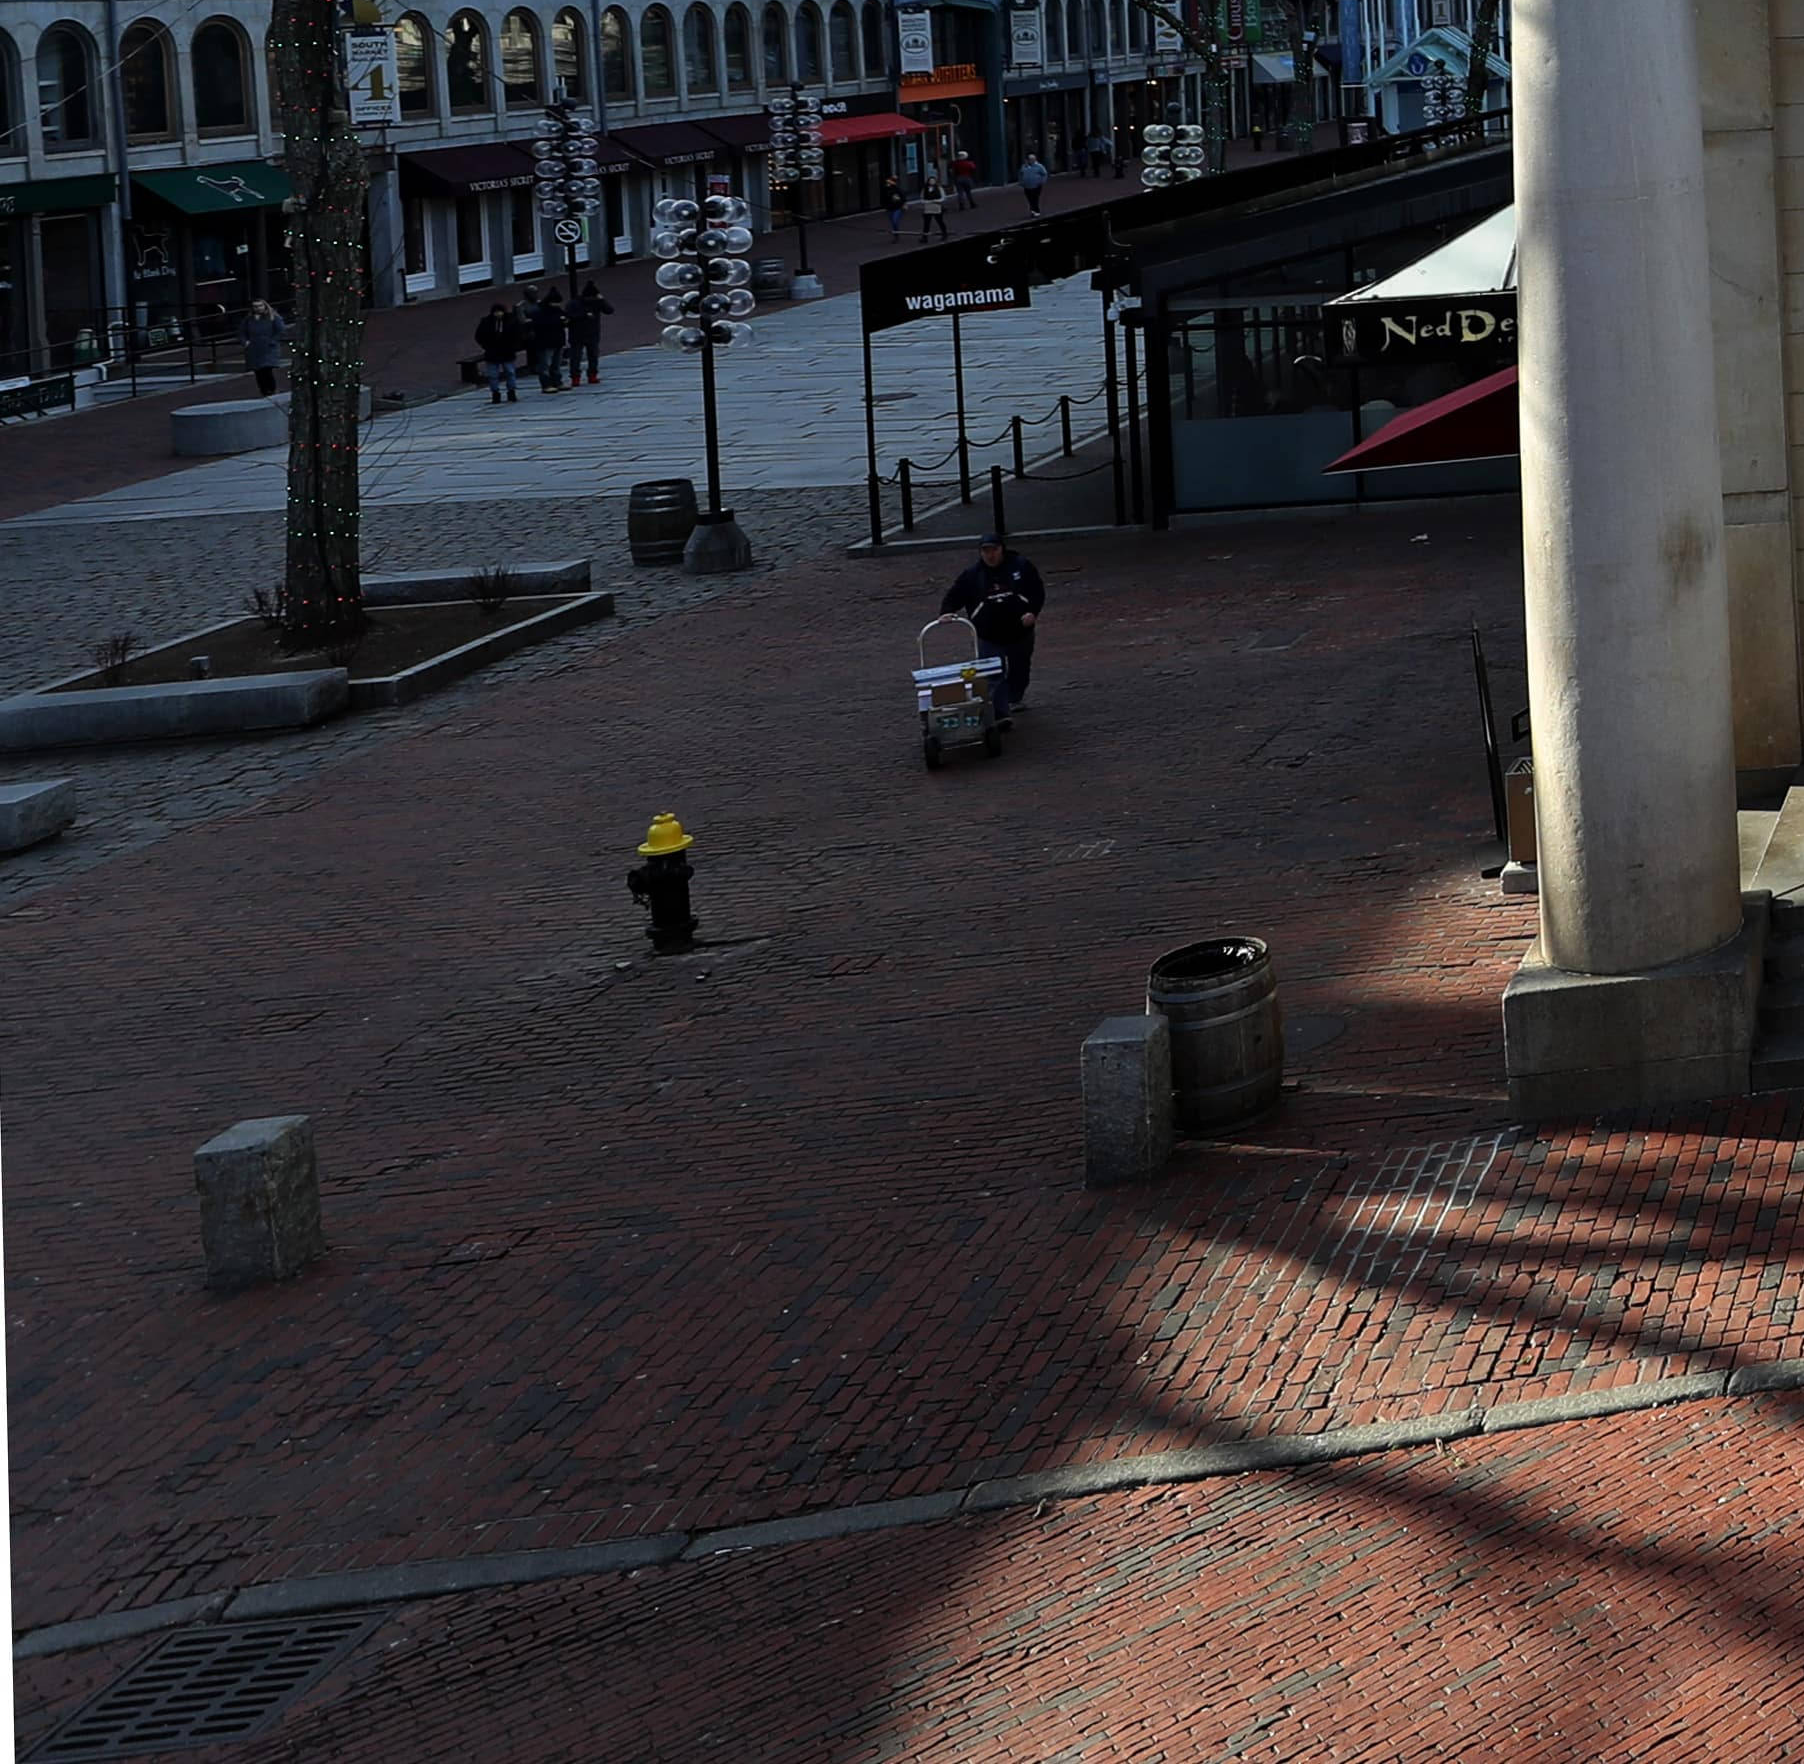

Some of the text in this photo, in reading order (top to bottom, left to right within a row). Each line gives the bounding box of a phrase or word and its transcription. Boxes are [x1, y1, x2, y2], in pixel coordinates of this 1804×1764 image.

[351, 64, 393, 101] 4
[905, 286, 1015, 312] wagamama
[1380, 310, 1454, 353] Ned
